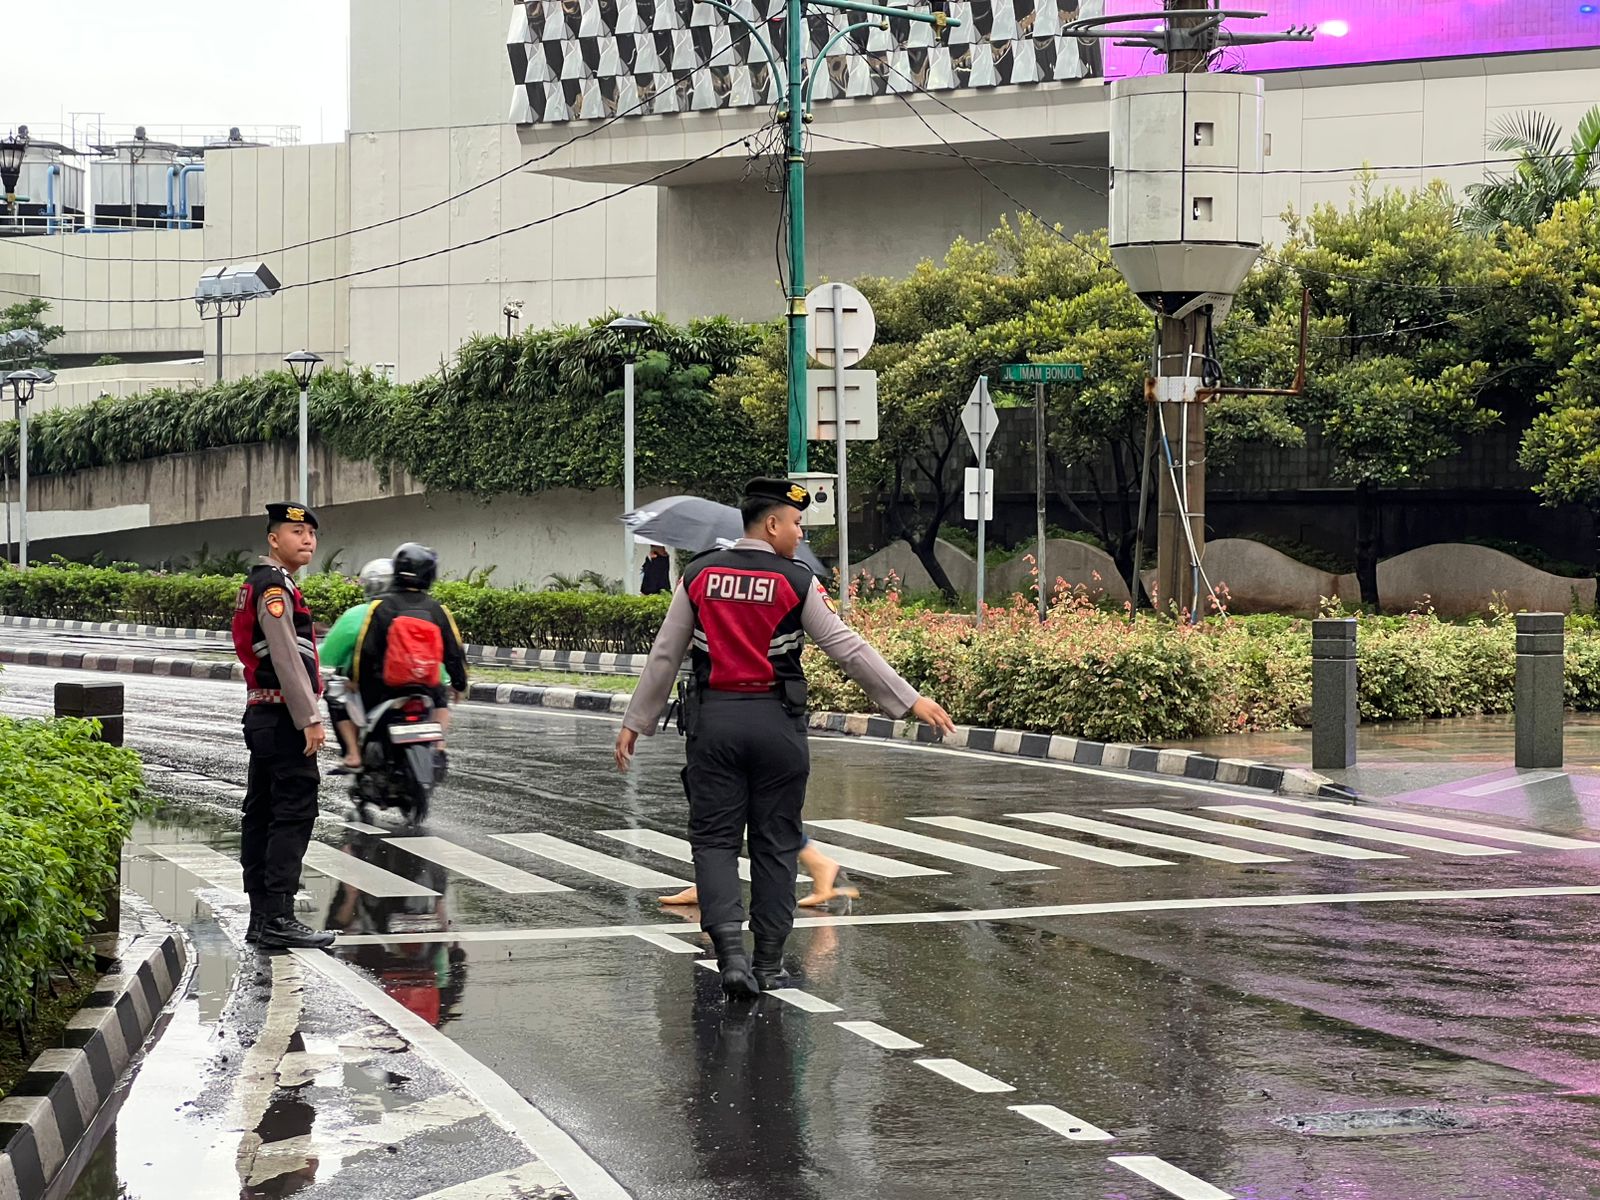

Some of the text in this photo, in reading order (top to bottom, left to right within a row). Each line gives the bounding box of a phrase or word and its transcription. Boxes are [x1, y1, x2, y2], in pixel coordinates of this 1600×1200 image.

[1019, 367, 1042, 380] IMAM
[1045, 367, 1079, 380] BONJOL
[706, 573, 775, 602] POLISI
